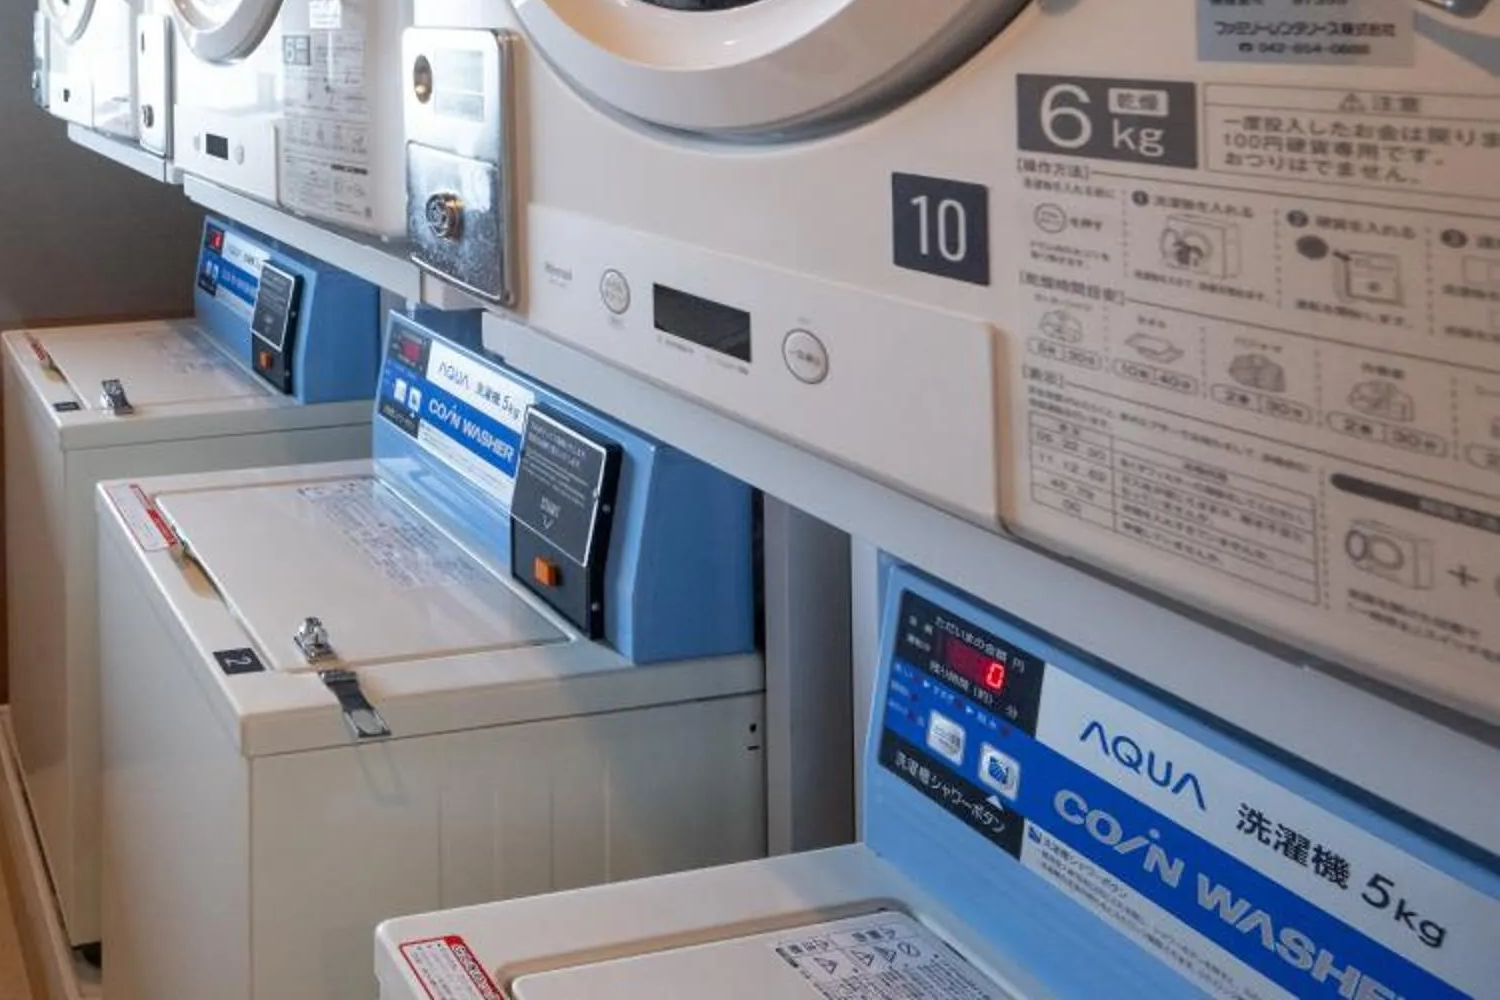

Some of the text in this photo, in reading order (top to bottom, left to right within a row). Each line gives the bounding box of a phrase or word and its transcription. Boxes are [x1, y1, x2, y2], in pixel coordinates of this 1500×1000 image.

[1040, 83, 1165, 158] 6 kg
[911, 195, 967, 263] 10
[986, 663, 1005, 689] 0
[1079, 720, 1207, 812] AQUA
[1234, 801, 1352, 891] 洗濯機
[1361, 871, 1448, 950] 5kg
